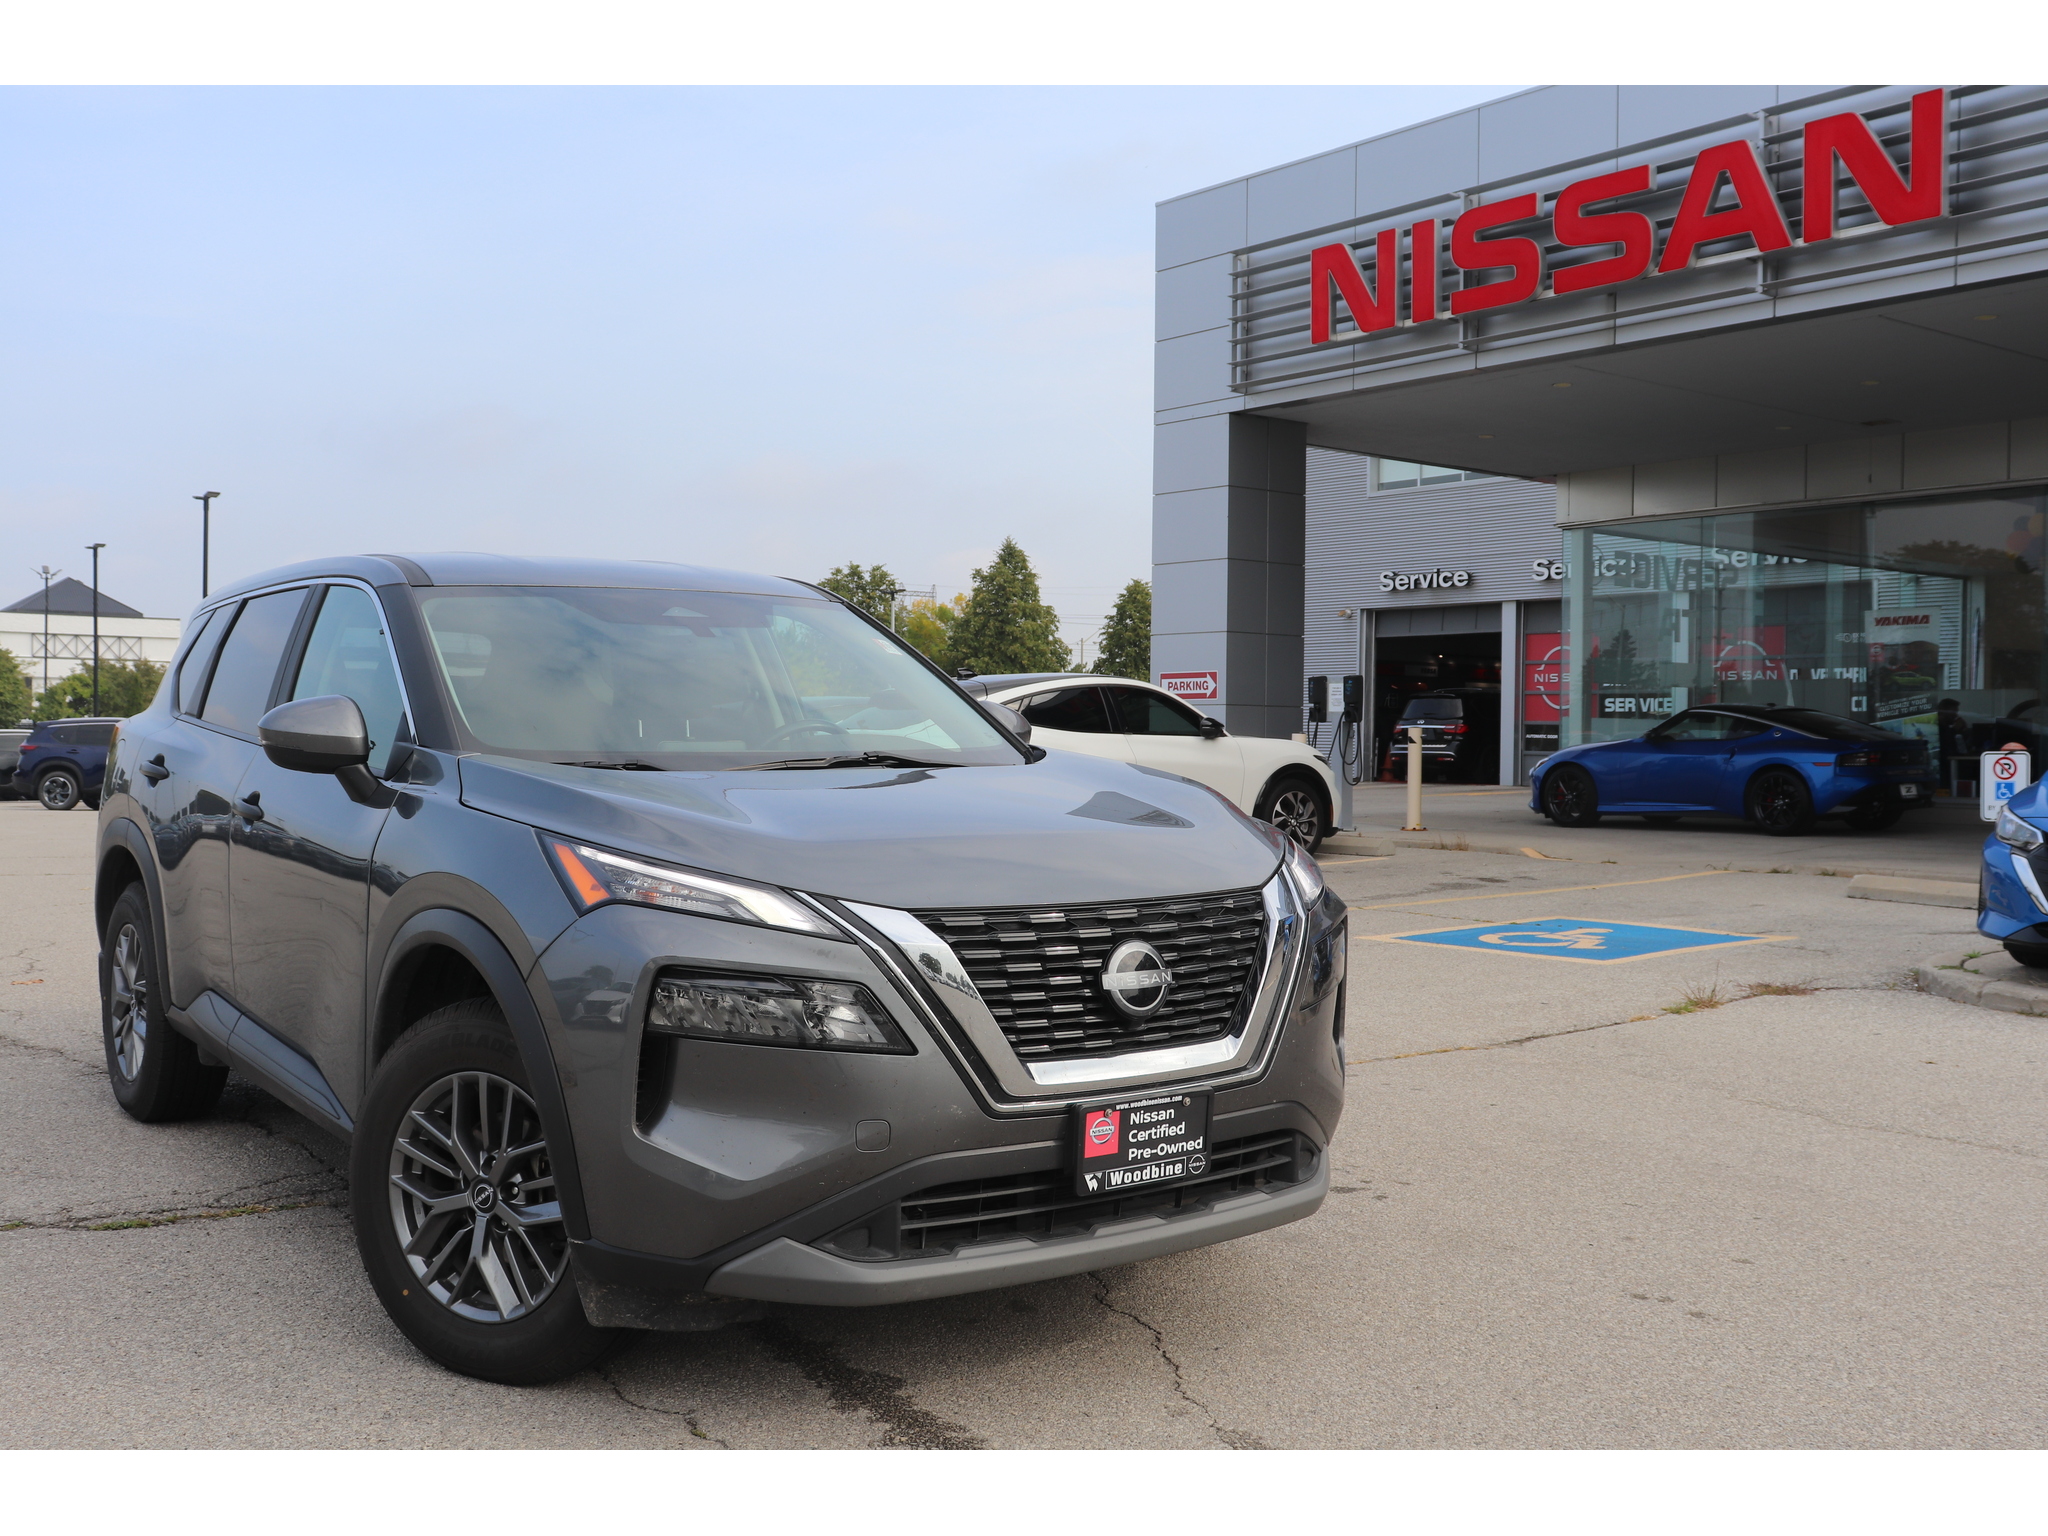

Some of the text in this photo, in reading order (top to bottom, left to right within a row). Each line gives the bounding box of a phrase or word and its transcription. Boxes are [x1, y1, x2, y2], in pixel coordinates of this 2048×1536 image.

[1310, 87, 1948, 344] NISSAN
[1379, 568, 1471, 592] Service
[1875, 614, 1931, 626] YAKIMA
[1167, 680, 1209, 691] PARKING
[1534, 673, 1570, 682] NISS
[1105, 971, 1171, 987] NISSAN
[1115, 1095, 1183, 1110] www.woodbinenissan.com
[1130, 1108, 1175, 1125] Nissan
[1091, 1127, 1113, 1135] NISSAN
[1128, 1121, 1185, 1143] Certified
[1128, 1136, 1203, 1161] Pre-Owned
[1109, 1162, 1183, 1186] Woodbine
